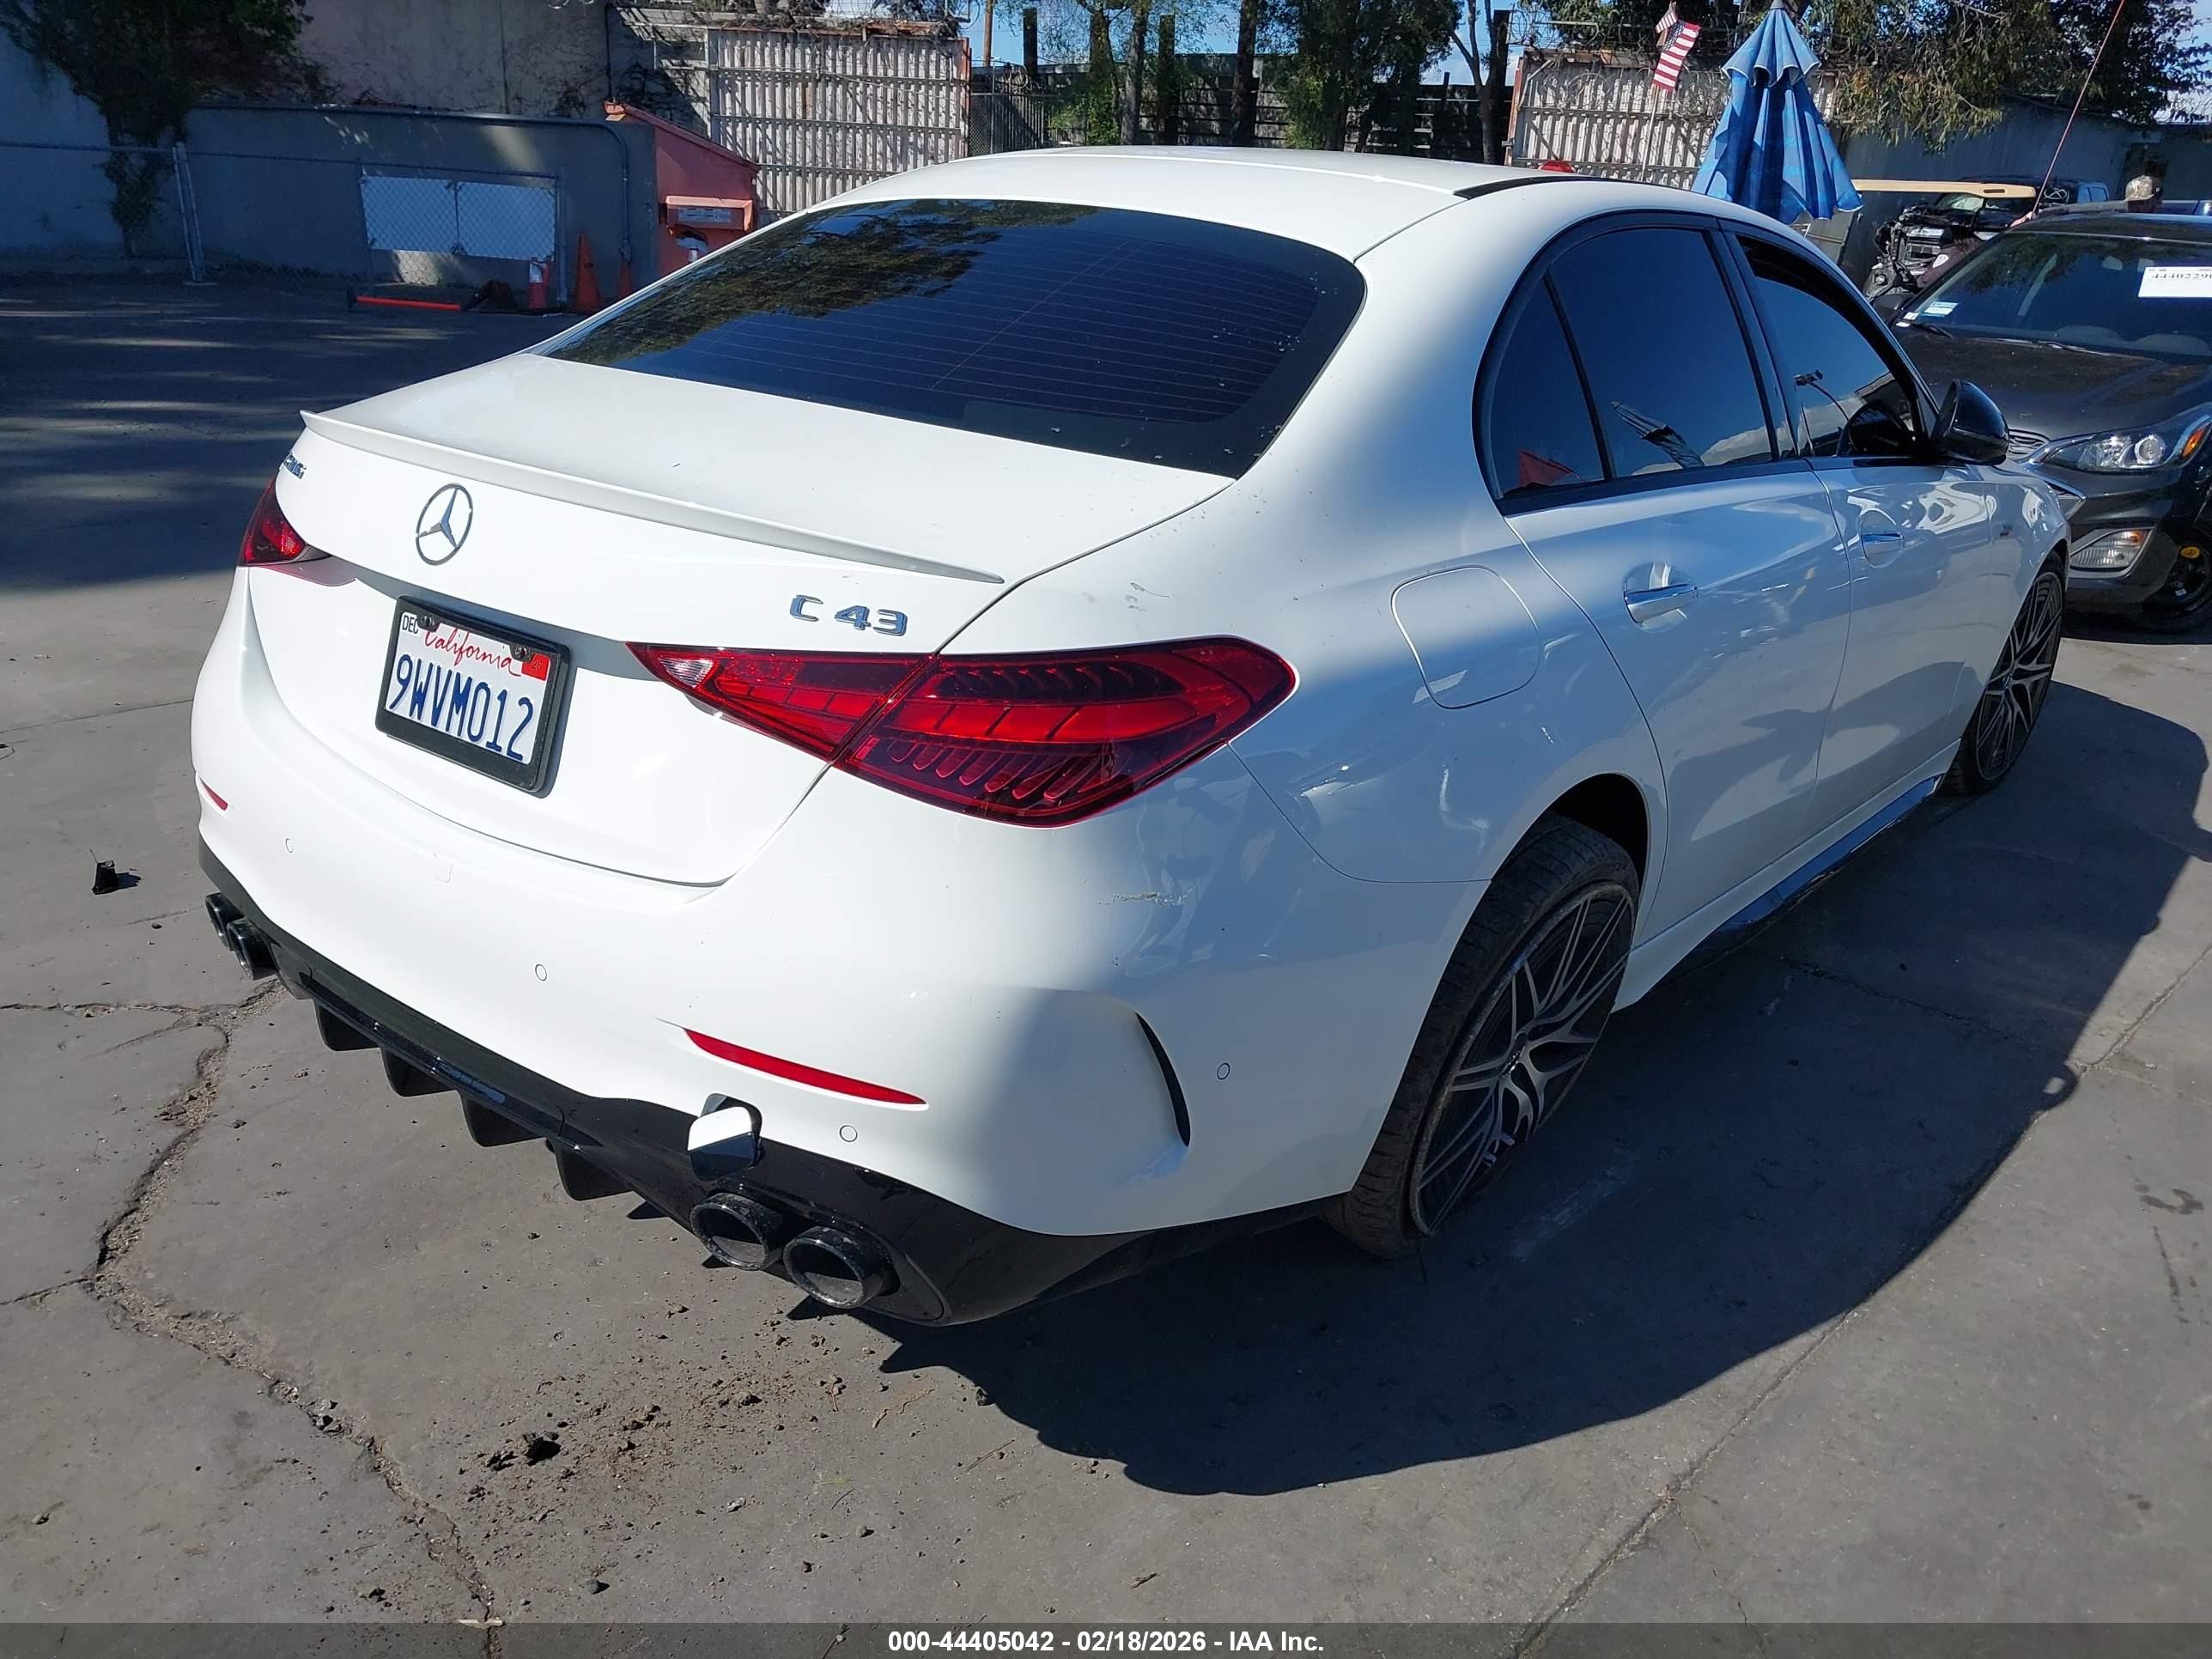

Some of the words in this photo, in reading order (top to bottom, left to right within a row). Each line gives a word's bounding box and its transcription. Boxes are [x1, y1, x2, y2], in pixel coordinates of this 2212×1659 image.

[402, 615, 418, 634] DEC
[789, 594, 823, 622] C
[834, 605, 908, 637] 43
[424, 628, 522, 677] California
[532, 659, 541, 670] 26
[389, 653, 534, 762] 9WVM012
